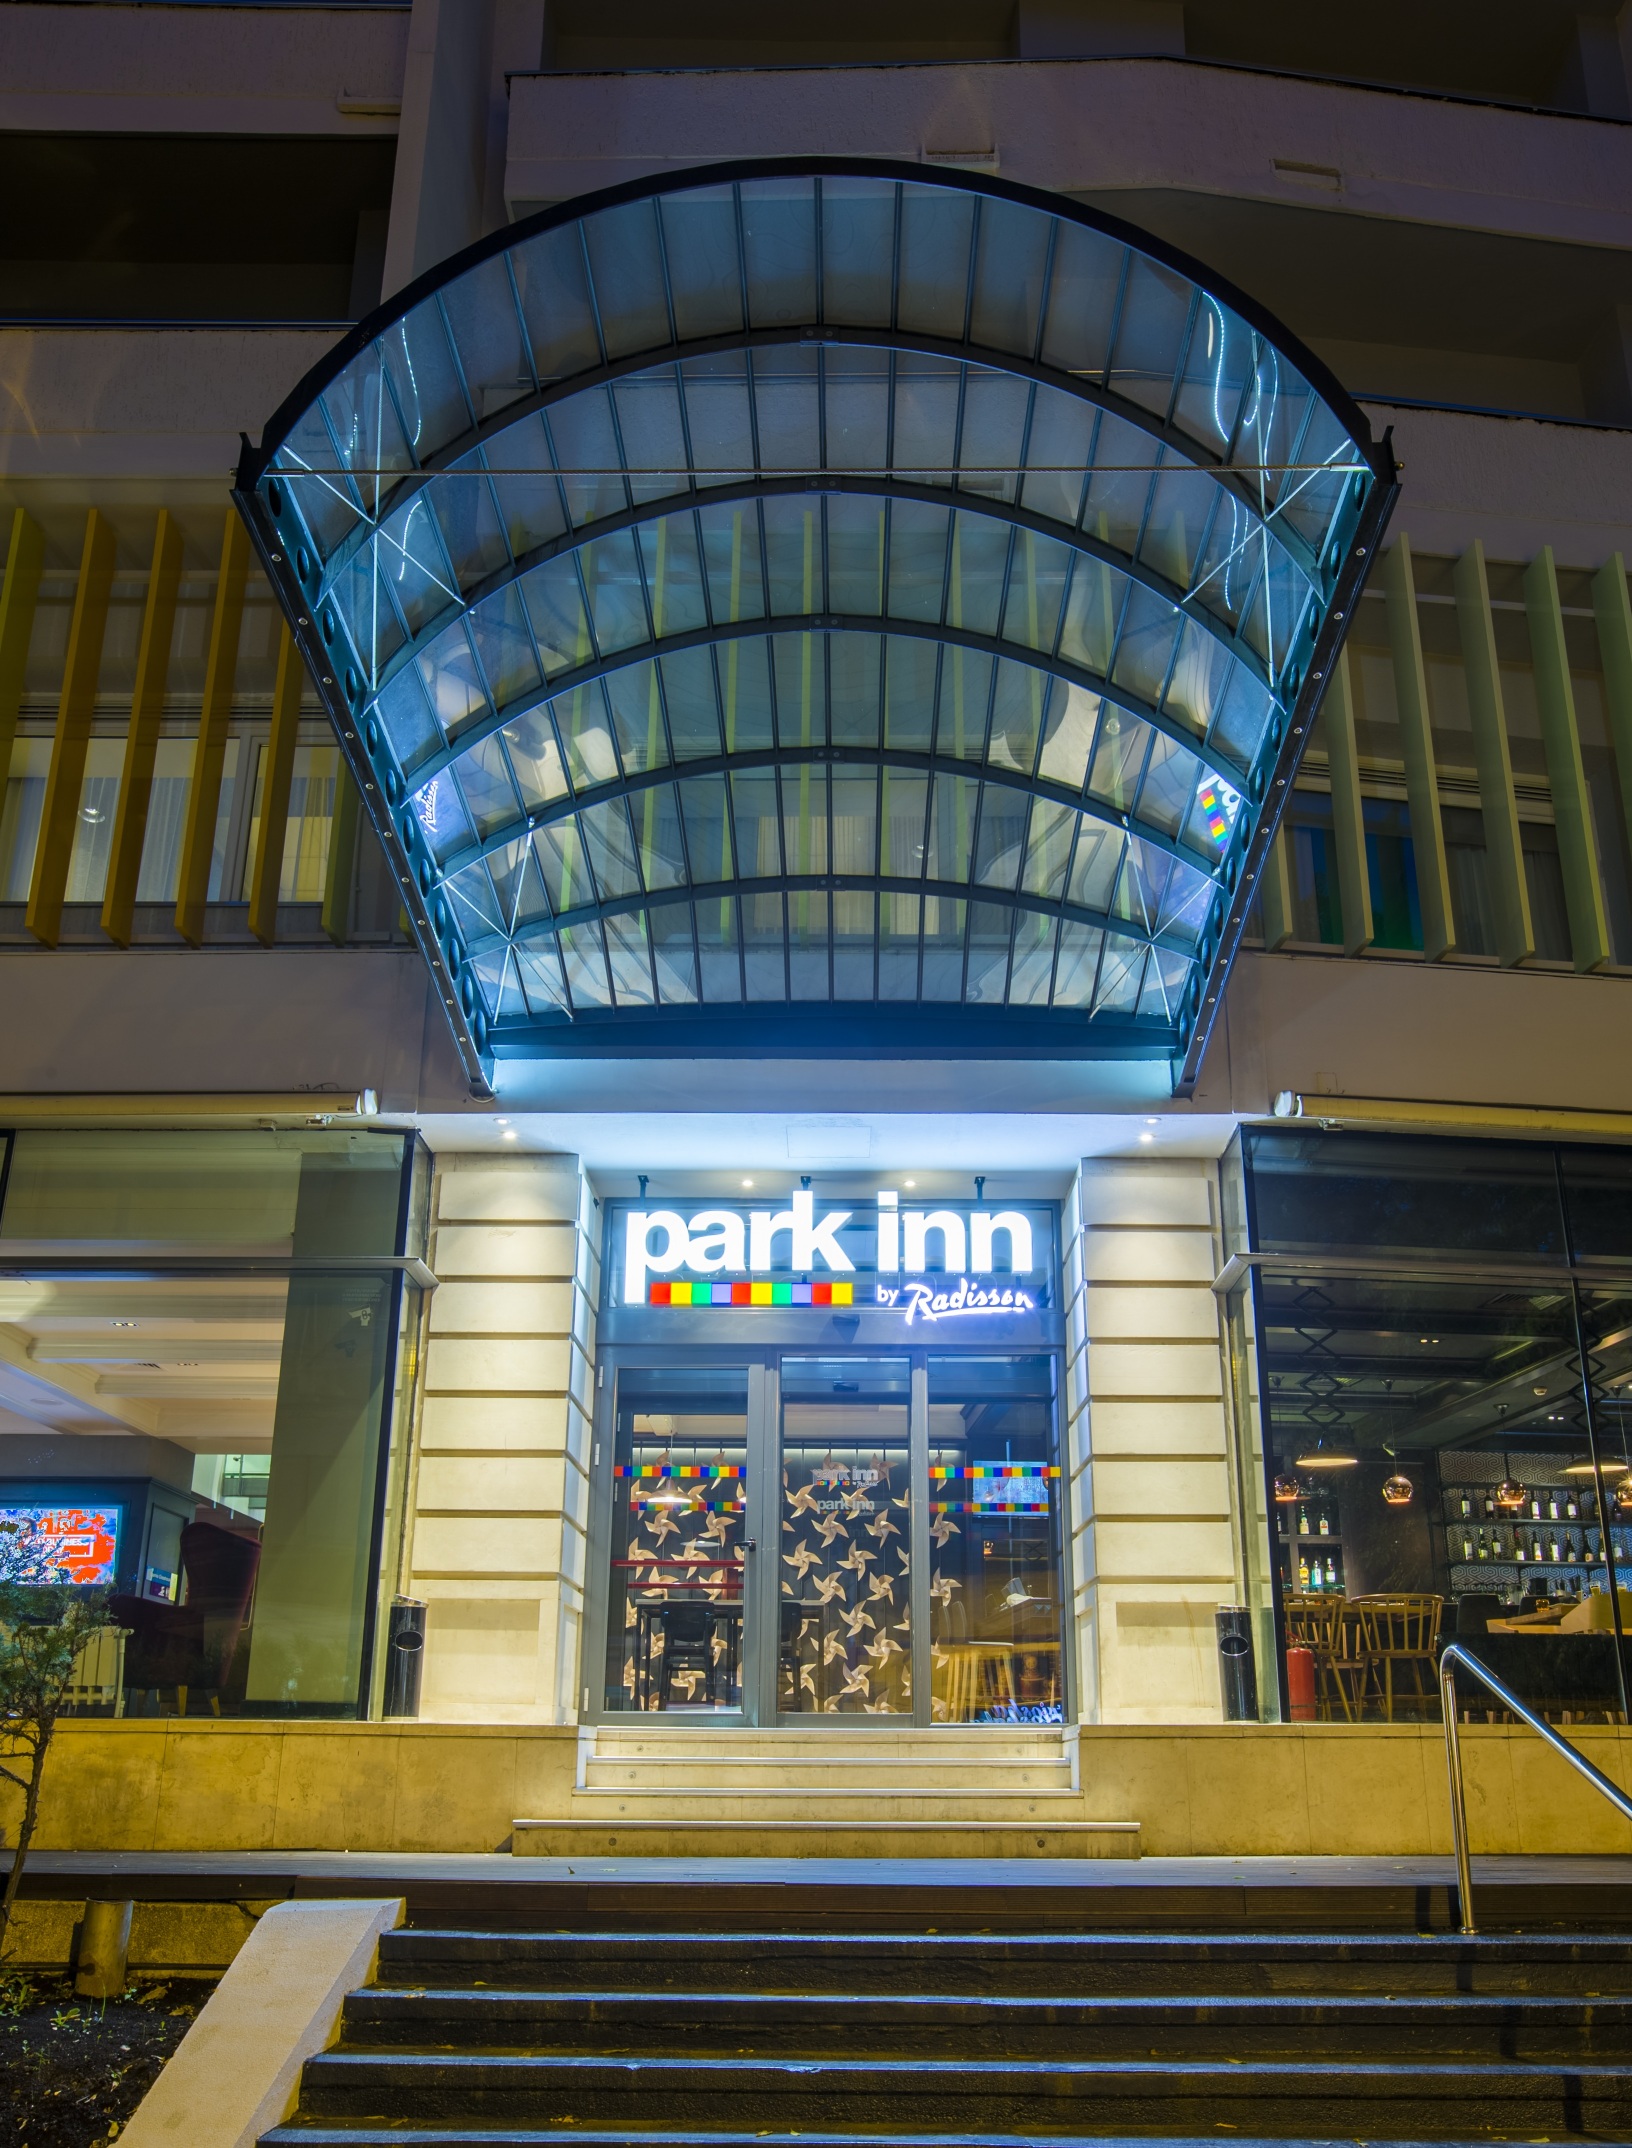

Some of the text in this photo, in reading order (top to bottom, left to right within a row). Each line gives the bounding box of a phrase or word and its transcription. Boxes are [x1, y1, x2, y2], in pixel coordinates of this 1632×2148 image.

[625, 1190, 1033, 1304] park inn
[877, 1278, 1034, 1325] by Radisson
[852, 1466, 879, 1481] inn
